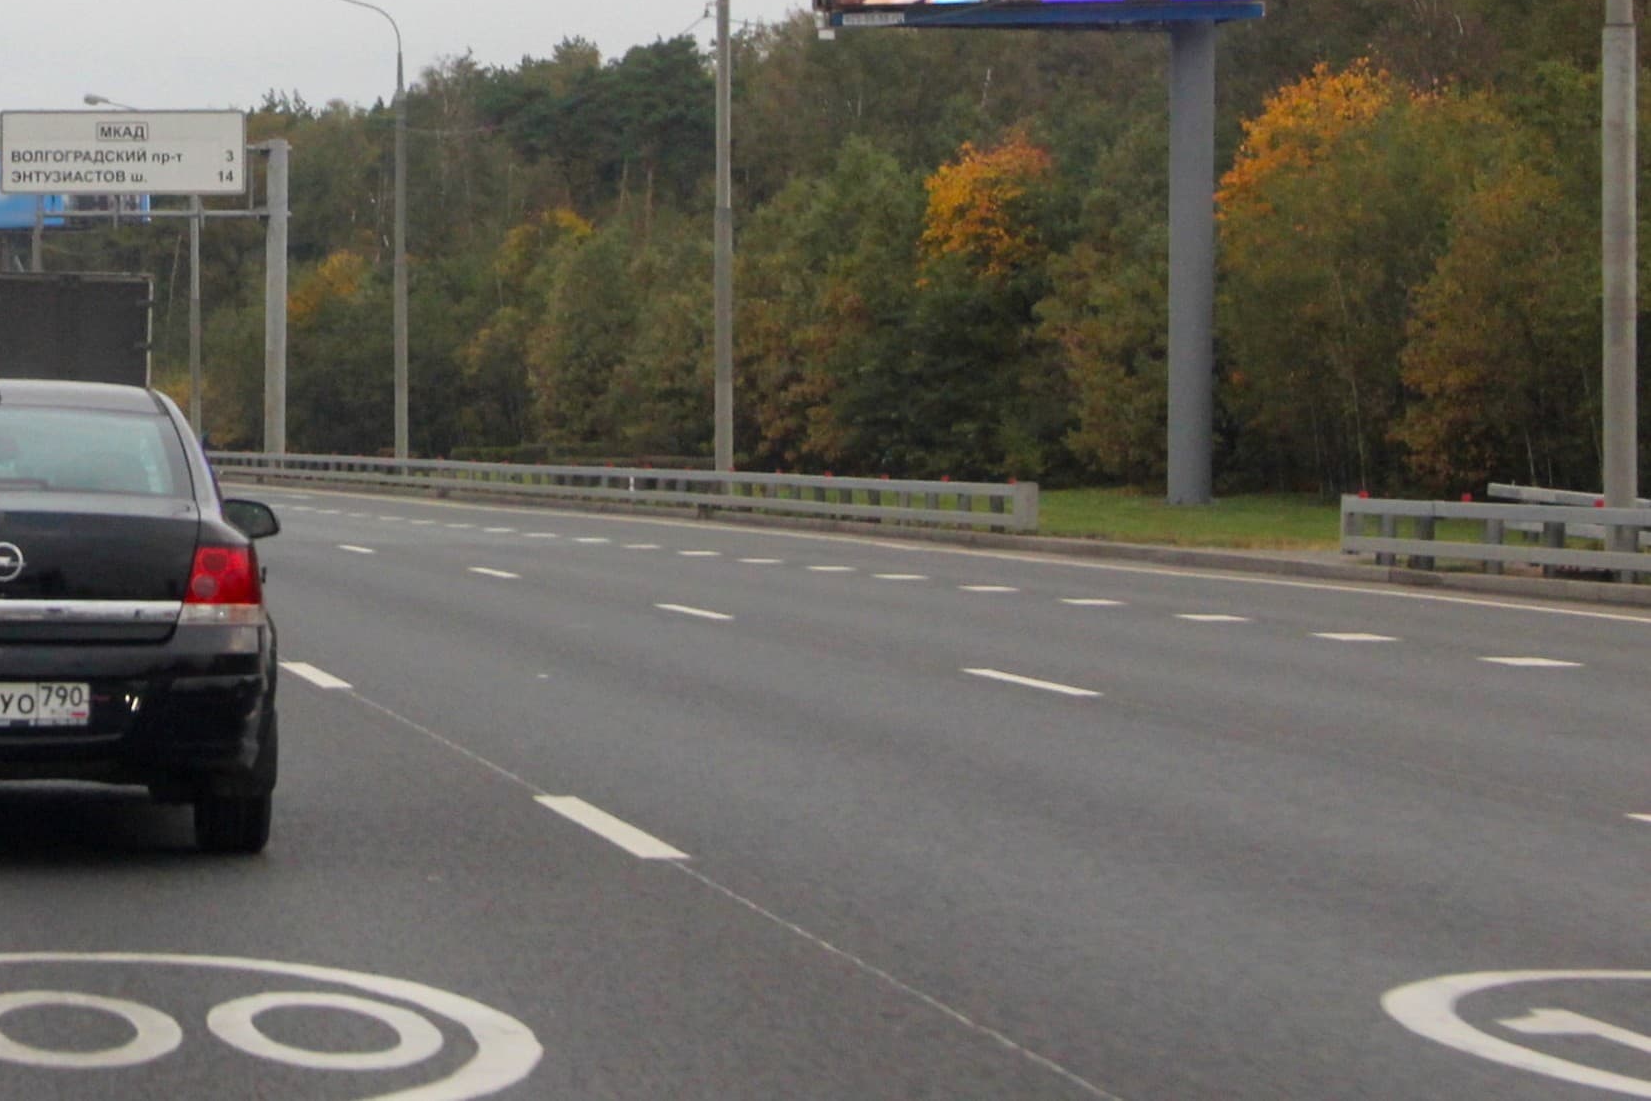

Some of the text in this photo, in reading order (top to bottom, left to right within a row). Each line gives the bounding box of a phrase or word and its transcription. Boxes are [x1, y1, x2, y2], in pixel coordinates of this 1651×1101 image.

[99, 126, 145, 139] МКАД
[11, 148, 147, 163] ВОЛГОГРАДСКИЙ
[225, 150, 235, 162] 3
[11, 170, 126, 183] ЭНТУЗИАСТОВ
[217, 170, 234, 183] 14
